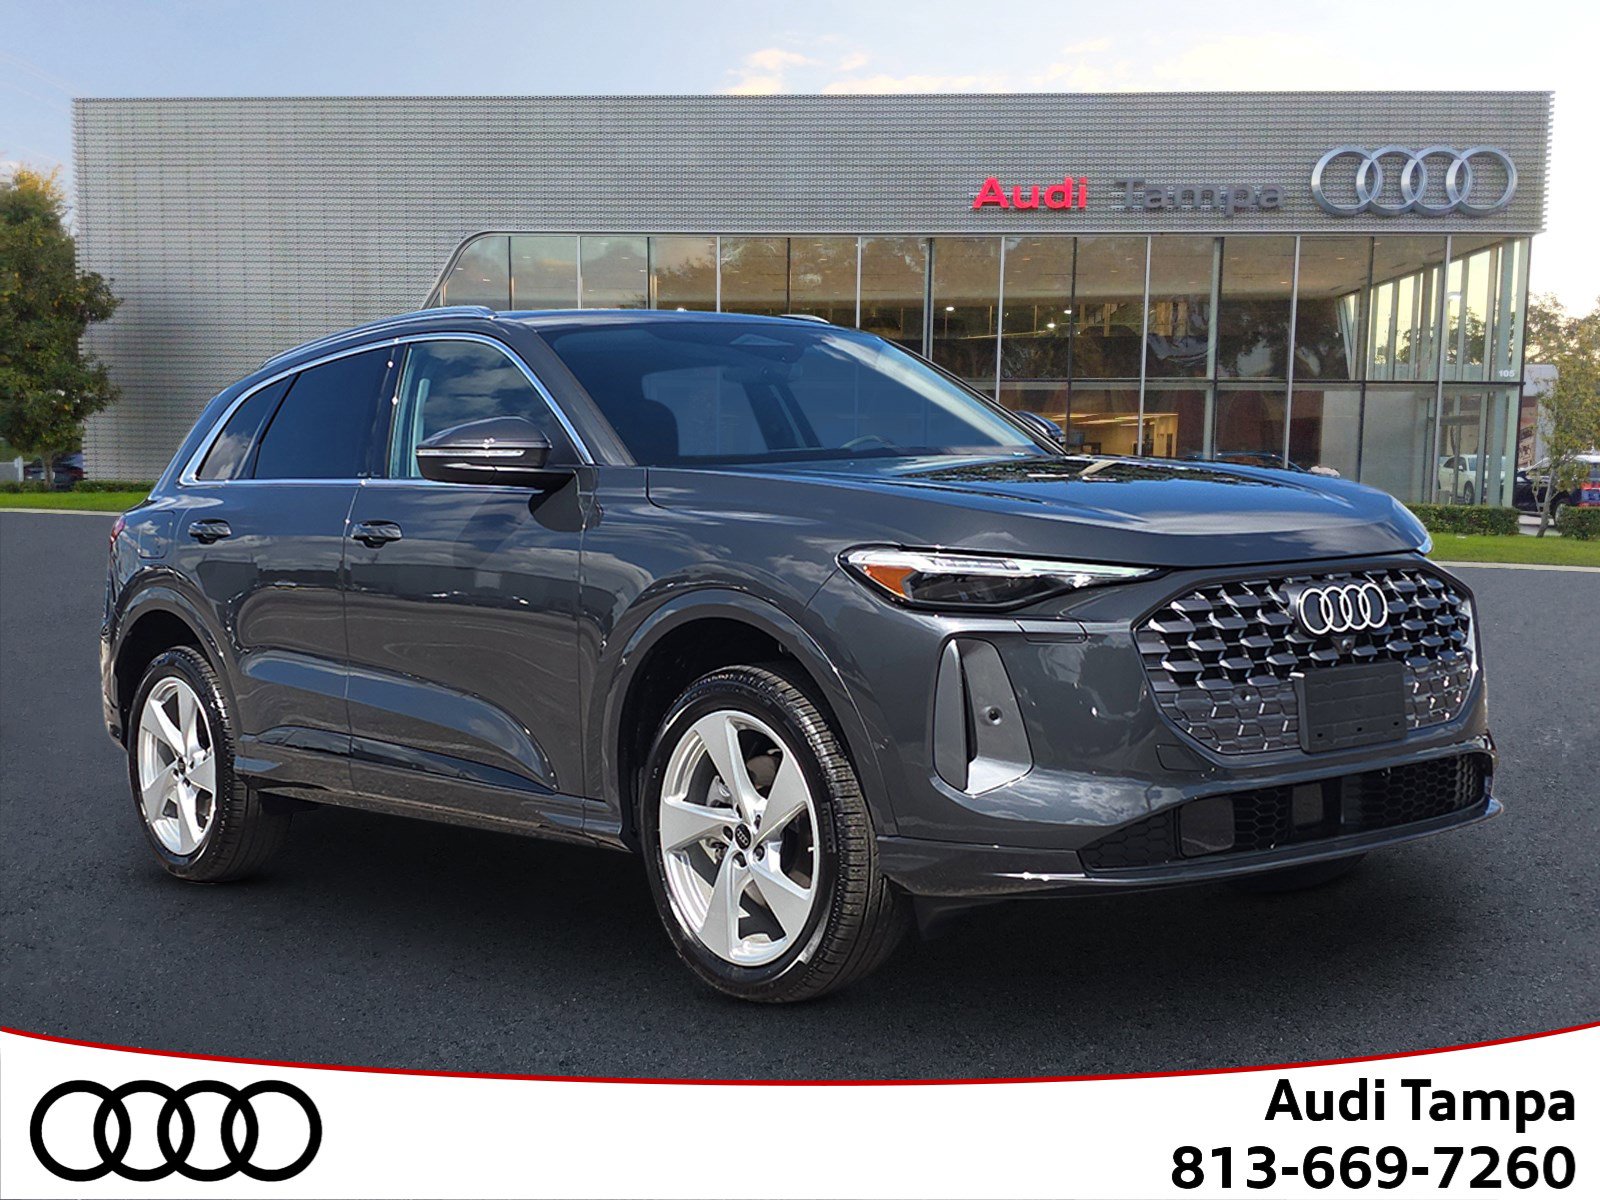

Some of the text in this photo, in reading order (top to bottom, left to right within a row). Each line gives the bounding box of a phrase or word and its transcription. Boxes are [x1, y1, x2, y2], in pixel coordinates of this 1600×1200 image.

[972, 176, 1285, 219] Audi Tampa
[1499, 369, 1515, 378] 105
